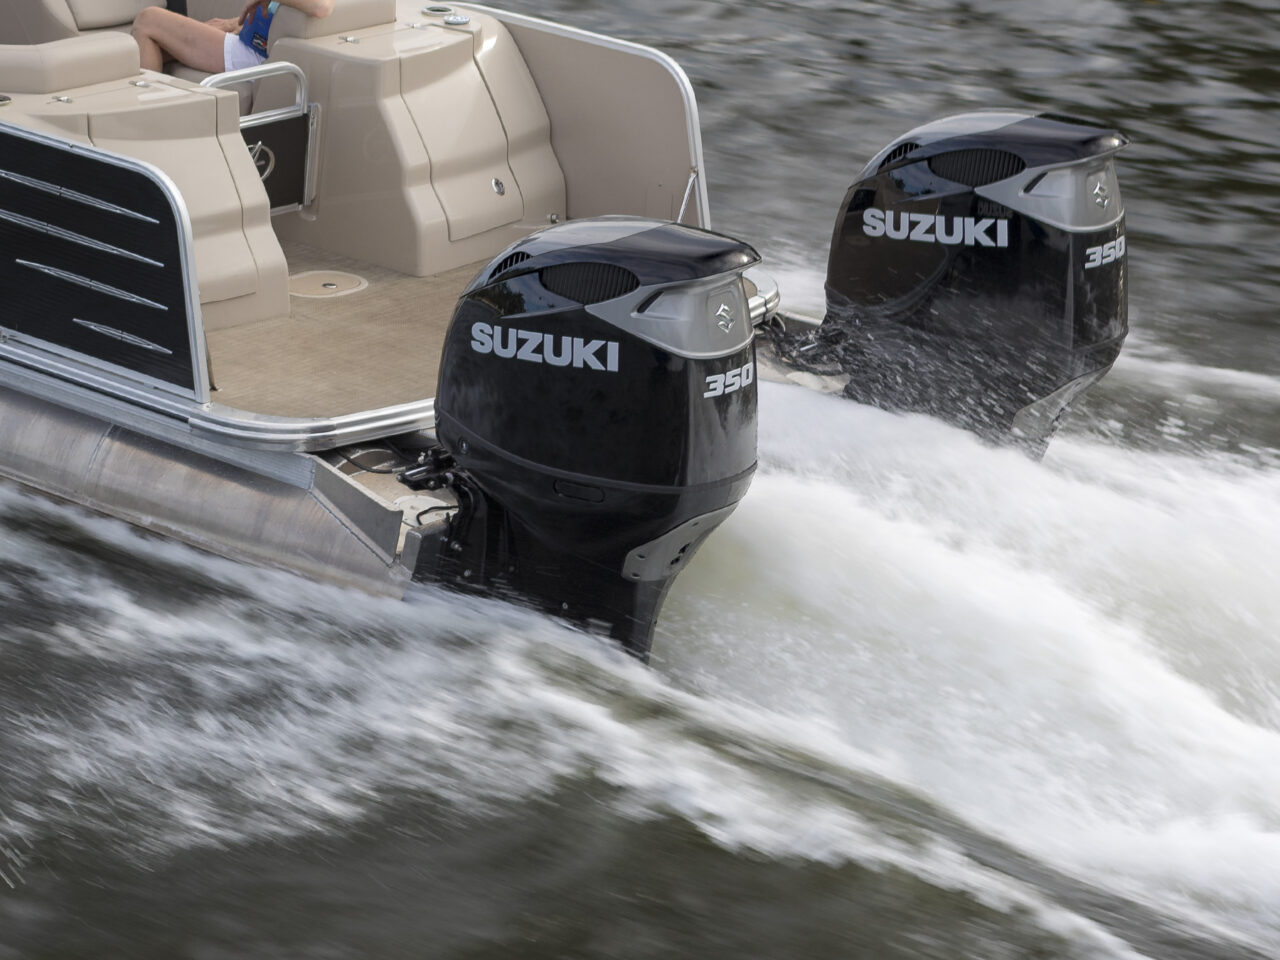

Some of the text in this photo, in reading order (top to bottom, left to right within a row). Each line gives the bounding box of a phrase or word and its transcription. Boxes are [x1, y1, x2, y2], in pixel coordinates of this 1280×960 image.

[863, 208, 1008, 248] SUZUKI
[1084, 235, 1126, 270] 350
[470, 321, 620, 373] SUZUKI
[703, 361, 754, 399] 350
